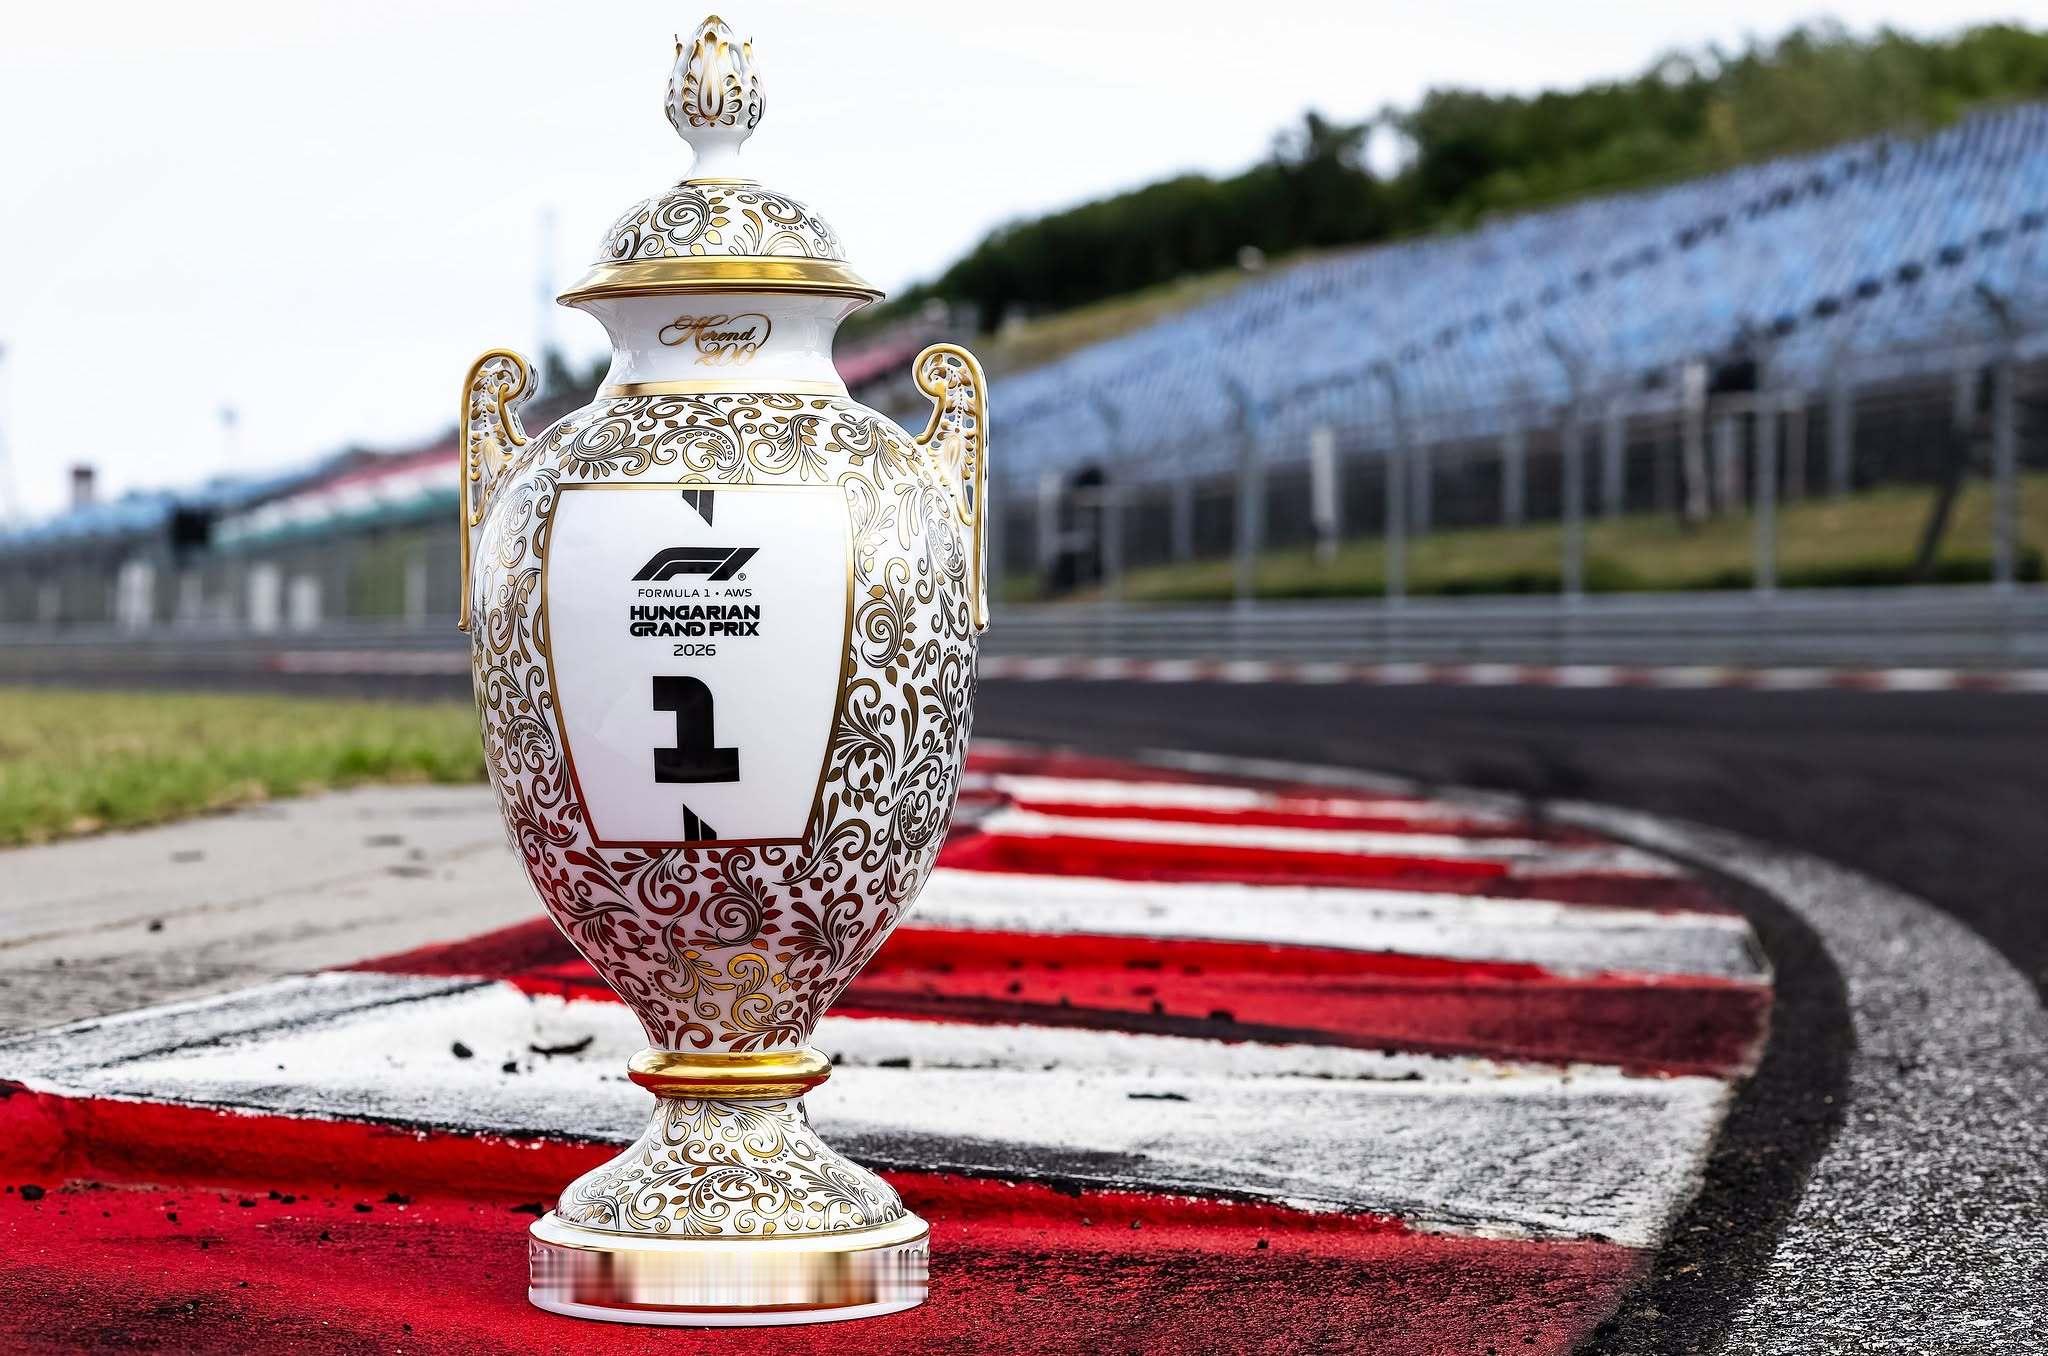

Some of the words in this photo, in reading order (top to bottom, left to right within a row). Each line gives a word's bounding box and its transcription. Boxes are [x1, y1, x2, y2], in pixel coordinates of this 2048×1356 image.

[659, 313, 772, 353] Herend
[694, 342, 757, 366] 200
[631, 547, 760, 582] F1
[638, 588, 701, 598] FORMULA
[705, 588, 711, 598] 1
[724, 588, 752, 598] AWS
[630, 605, 760, 621] HUNGARIAN
[630, 622, 706, 637] GRAND
[709, 622, 760, 637] PRIX
[673, 643, 717, 657] 2026
[652, 675, 740, 784] 1
